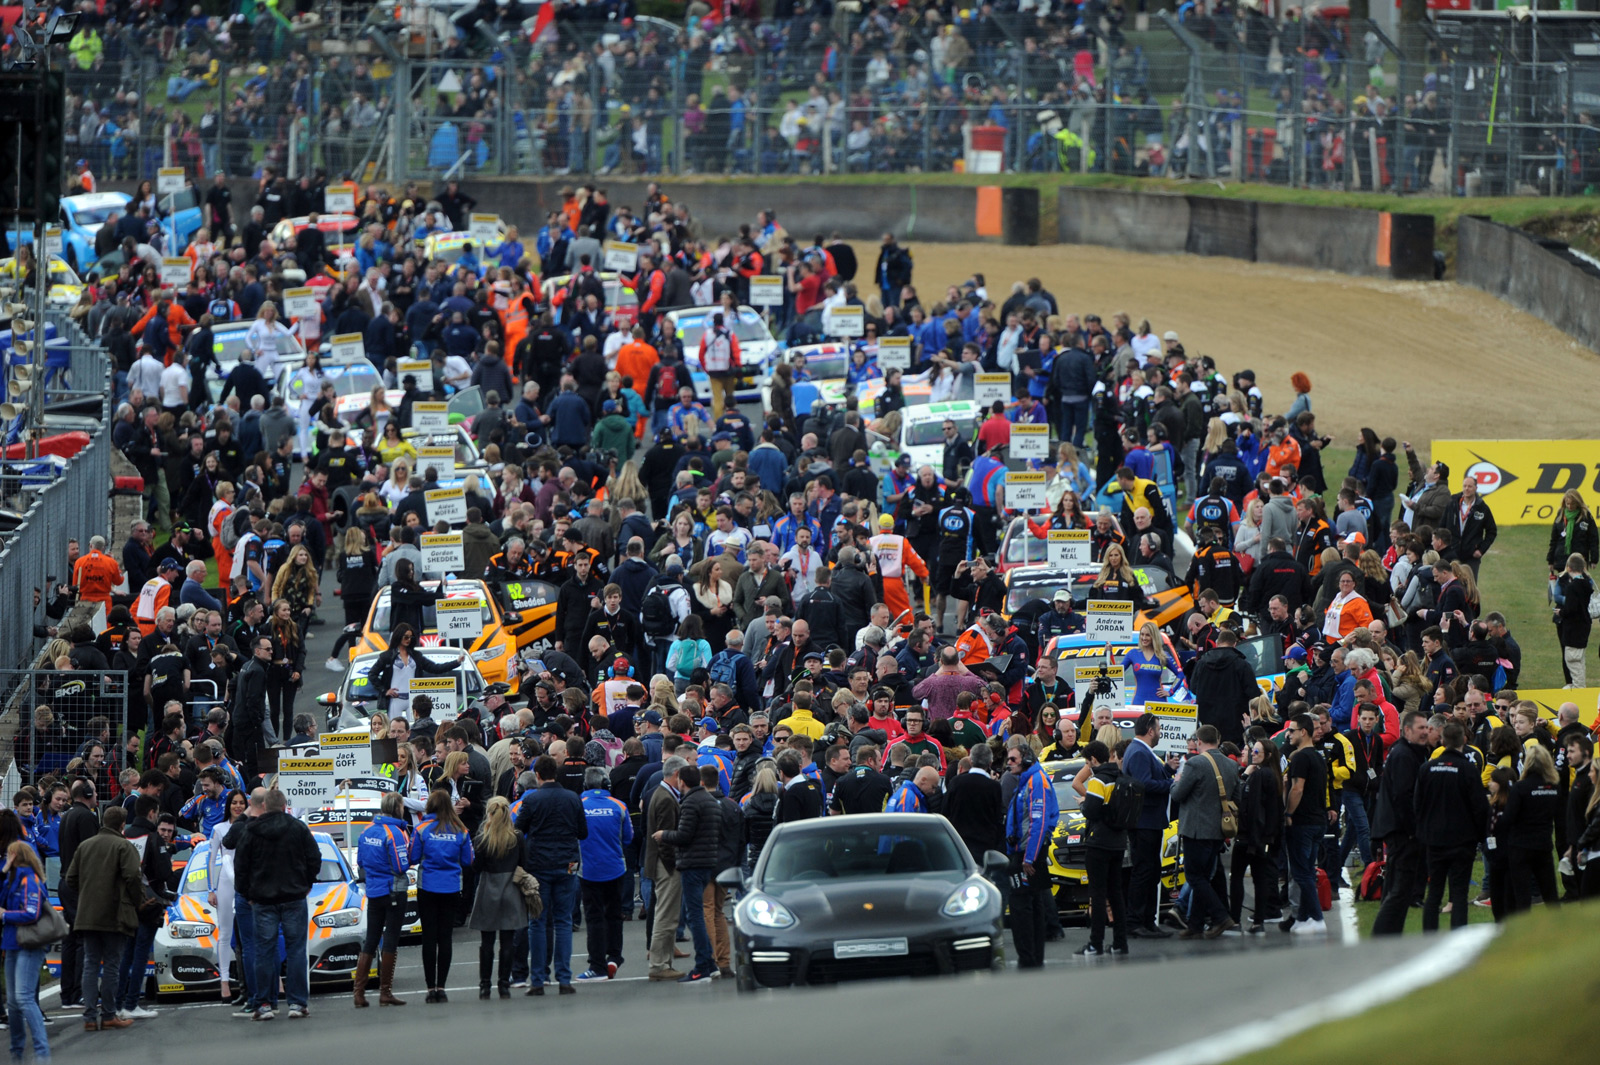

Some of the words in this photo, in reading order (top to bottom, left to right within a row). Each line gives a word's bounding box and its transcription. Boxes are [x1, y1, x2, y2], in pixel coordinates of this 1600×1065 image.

[429, 536, 461, 544] DUNLOP
[427, 556, 459, 564] SHEDDEN
[507, 583, 526, 600] 52
[513, 597, 547, 609] Shedden
[1094, 624, 1126, 632] JORDAN
[352, 677, 368, 687] 40
[418, 680, 454, 688] DUNLOP
[1154, 704, 1196, 715] DUNLOP
[1159, 723, 1182, 732] Adam
[330, 734, 370, 743] DUNLOP
[336, 752, 355, 760] Jack
[290, 761, 333, 769] DUNLOP
[336, 759, 357, 767] GOFF
[297, 779, 317, 788] Sam
[286, 788, 328, 797] TORDOFF
[584, 807, 614, 815] WSR
[320, 916, 335, 926] HiQ
[195, 925, 211, 936] HiQ
[837, 942, 906, 952] PORSCHE
[328, 954, 359, 964] Gumtree
[177, 965, 206, 975] Gumtree
